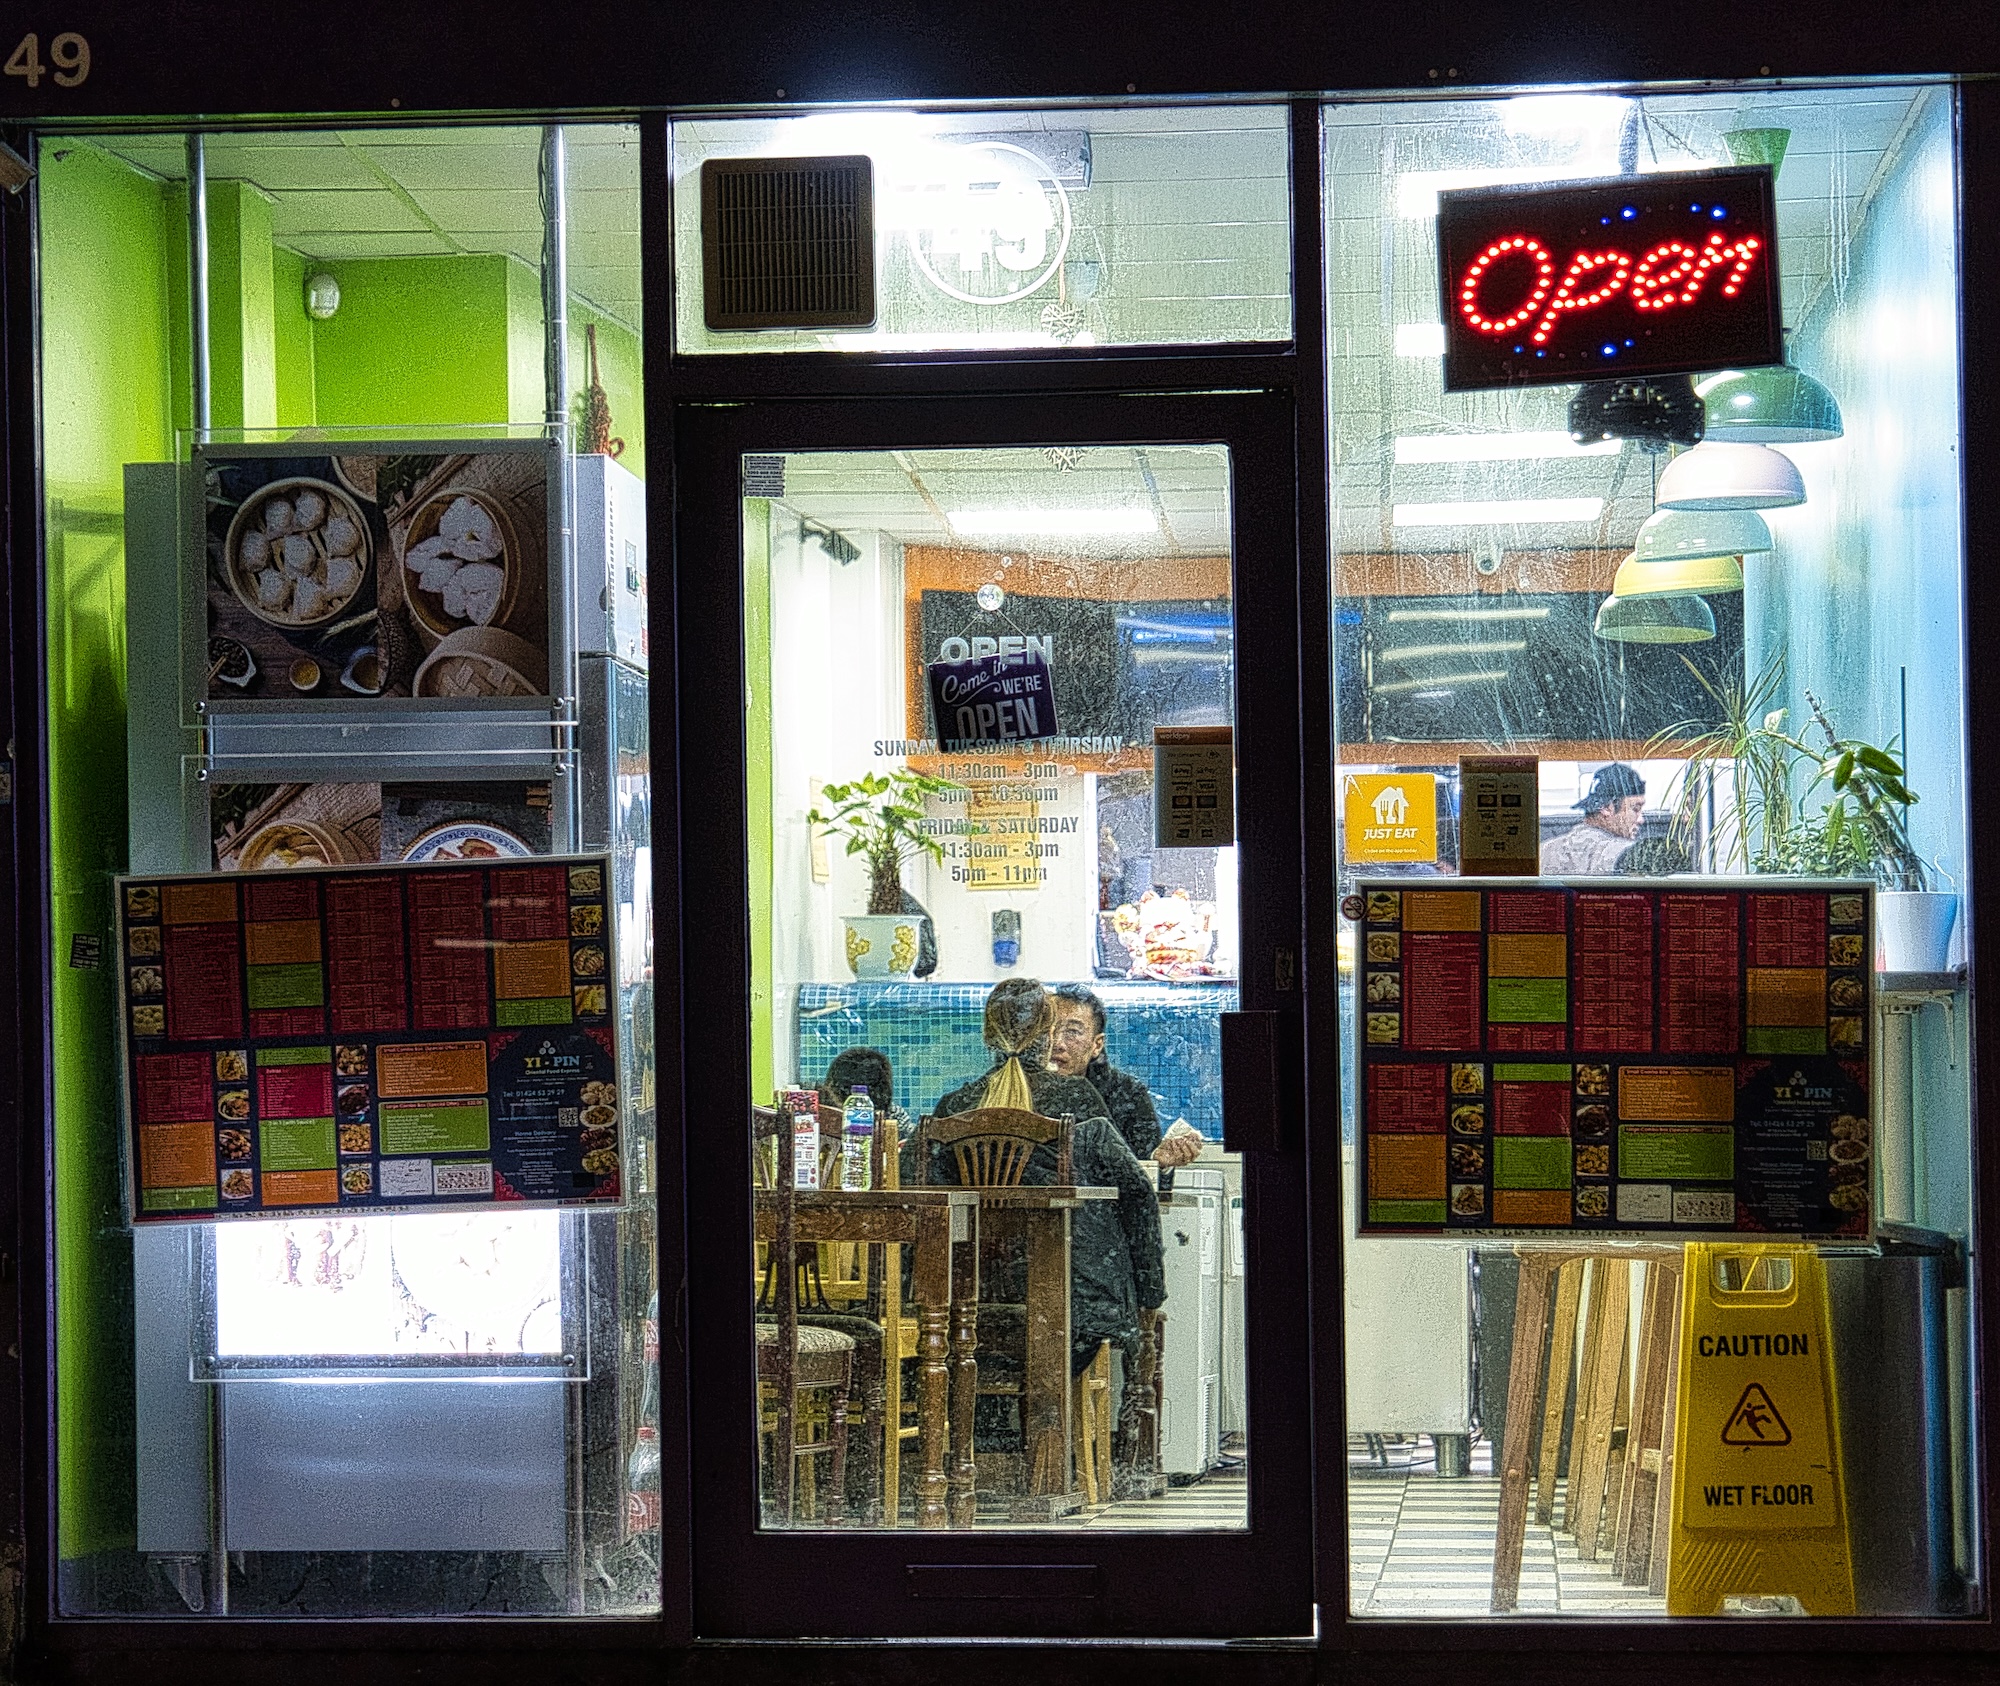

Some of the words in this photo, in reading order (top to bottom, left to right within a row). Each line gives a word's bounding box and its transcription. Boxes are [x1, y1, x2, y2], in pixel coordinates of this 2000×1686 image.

[4, 33, 91, 88] 49
[1462, 234, 1760, 343] Open
[940, 635, 1053, 666] OPEN
[941, 671, 990, 703] Come
[1002, 674, 1042, 695] WE'RE
[956, 697, 1040, 741] OPEN
[946, 739, 1016, 755] TUESDAY
[1039, 736, 1123, 755] THURSDAY
[940, 763, 1006, 779] 11:30am
[1023, 762, 1059, 779] 3pm
[939, 787, 973, 804] 5pm
[919, 818, 972, 835] FRIDAY
[998, 817, 1079, 834] SATURDAY
[1364, 827, 1393, 841] JUST
[1394, 827, 1418, 839] EAT
[940, 842, 1007, 858] 11:30am
[1025, 841, 1059, 859] 3pm
[952, 866, 986, 883] 5pm
[1003, 865, 1047, 882] 11pm
[524, 1056, 542, 1069] YI
[553, 1055, 580, 1067] PIN
[1773, 1086, 1792, 1098] YI
[1804, 1087, 1833, 1098] PIN
[1700, 1333, 1808, 1357] CAUTION
[1703, 1485, 1745, 1506] WET
[1751, 1484, 1814, 1506] FLOOR
